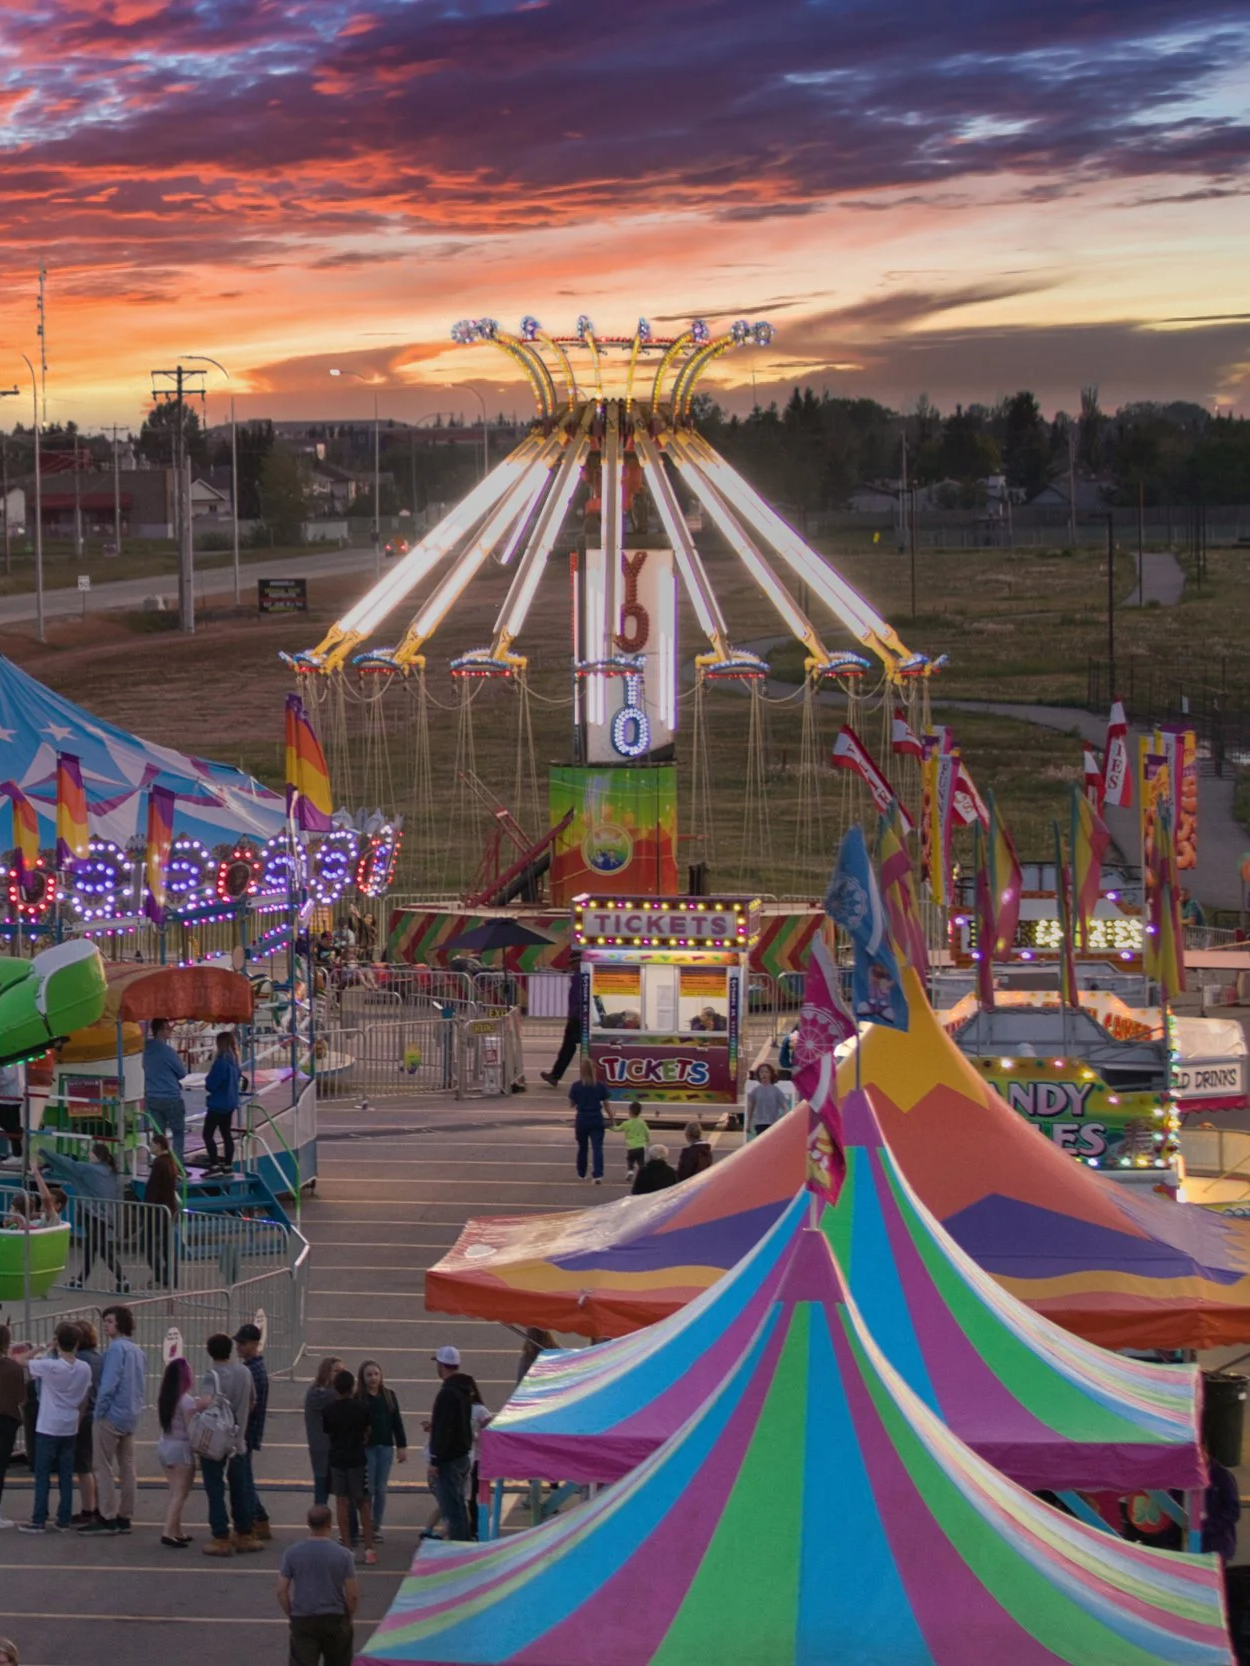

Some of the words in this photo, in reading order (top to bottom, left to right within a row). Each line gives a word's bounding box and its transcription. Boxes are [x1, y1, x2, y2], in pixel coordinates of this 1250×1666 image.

[594, 914, 727, 935] TICKETS
[601, 1056, 710, 1085] TICKETS
[1195, 1068, 1237, 1089] DRINKS
